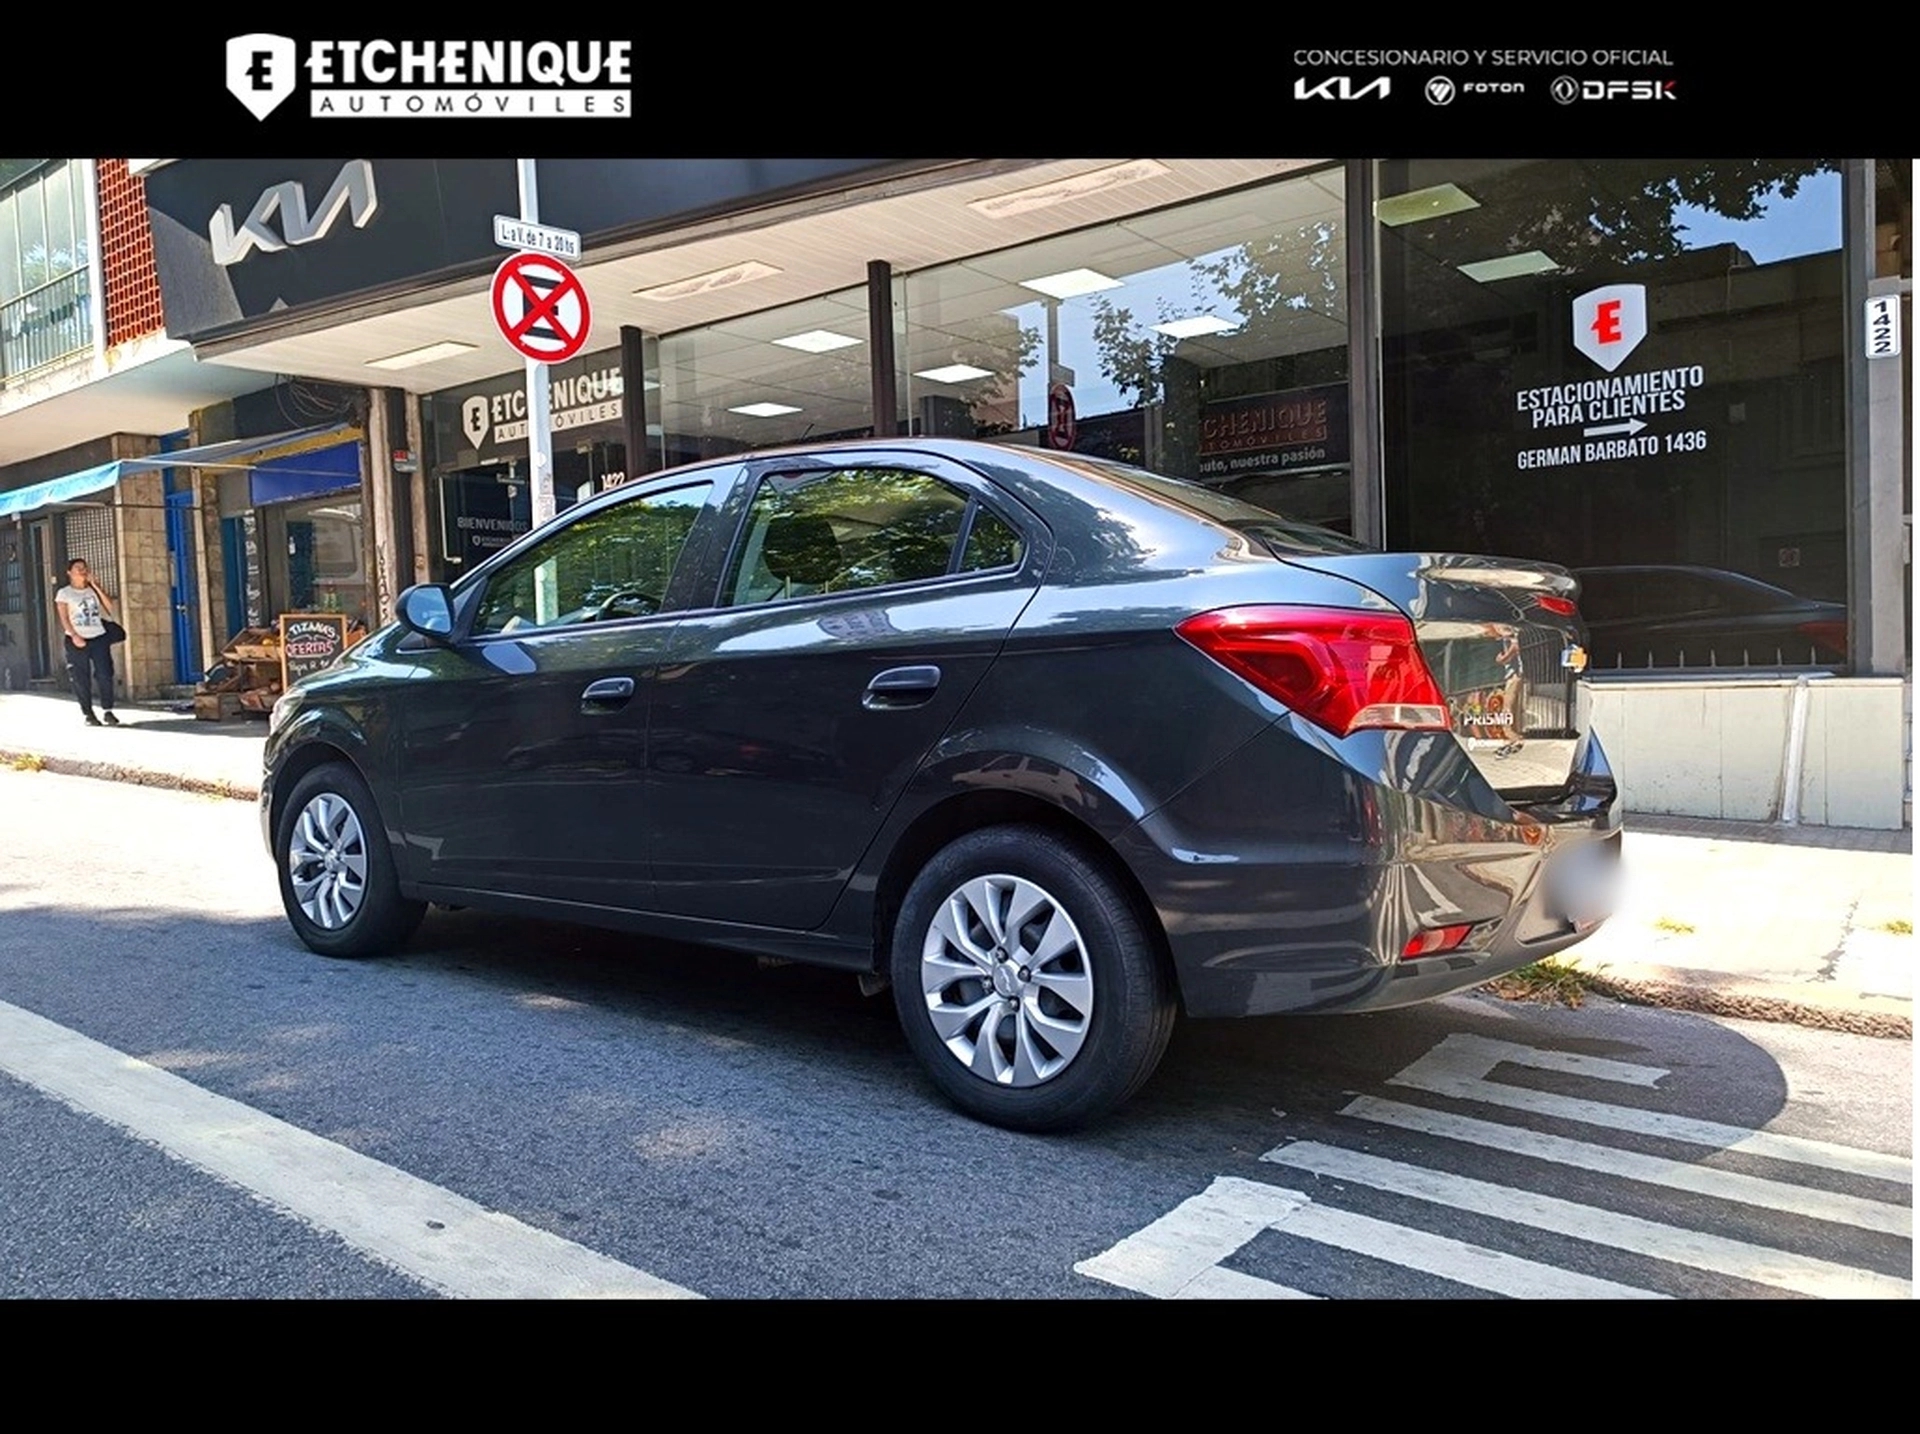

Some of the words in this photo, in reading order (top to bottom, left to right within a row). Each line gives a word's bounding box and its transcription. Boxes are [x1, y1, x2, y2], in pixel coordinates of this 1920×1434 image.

[209, 159, 377, 266] KIA
[1872, 301, 1891, 354] 1422
[1517, 365, 1704, 411] ESTACIONAMIENTO
[1532, 404, 1584, 428] PARA
[1589, 390, 1686, 421] CLIENTES
[1230, 453, 1279, 469] nuestra
[1281, 446, 1326, 466] pasión
[1517, 444, 1581, 470] GERMAN
[1585, 436, 1659, 463] BARBATO
[1665, 430, 1707, 453] 1436
[457, 516, 529, 533] BIENVENIDOS
[1464, 712, 1514, 727] PRISMA
